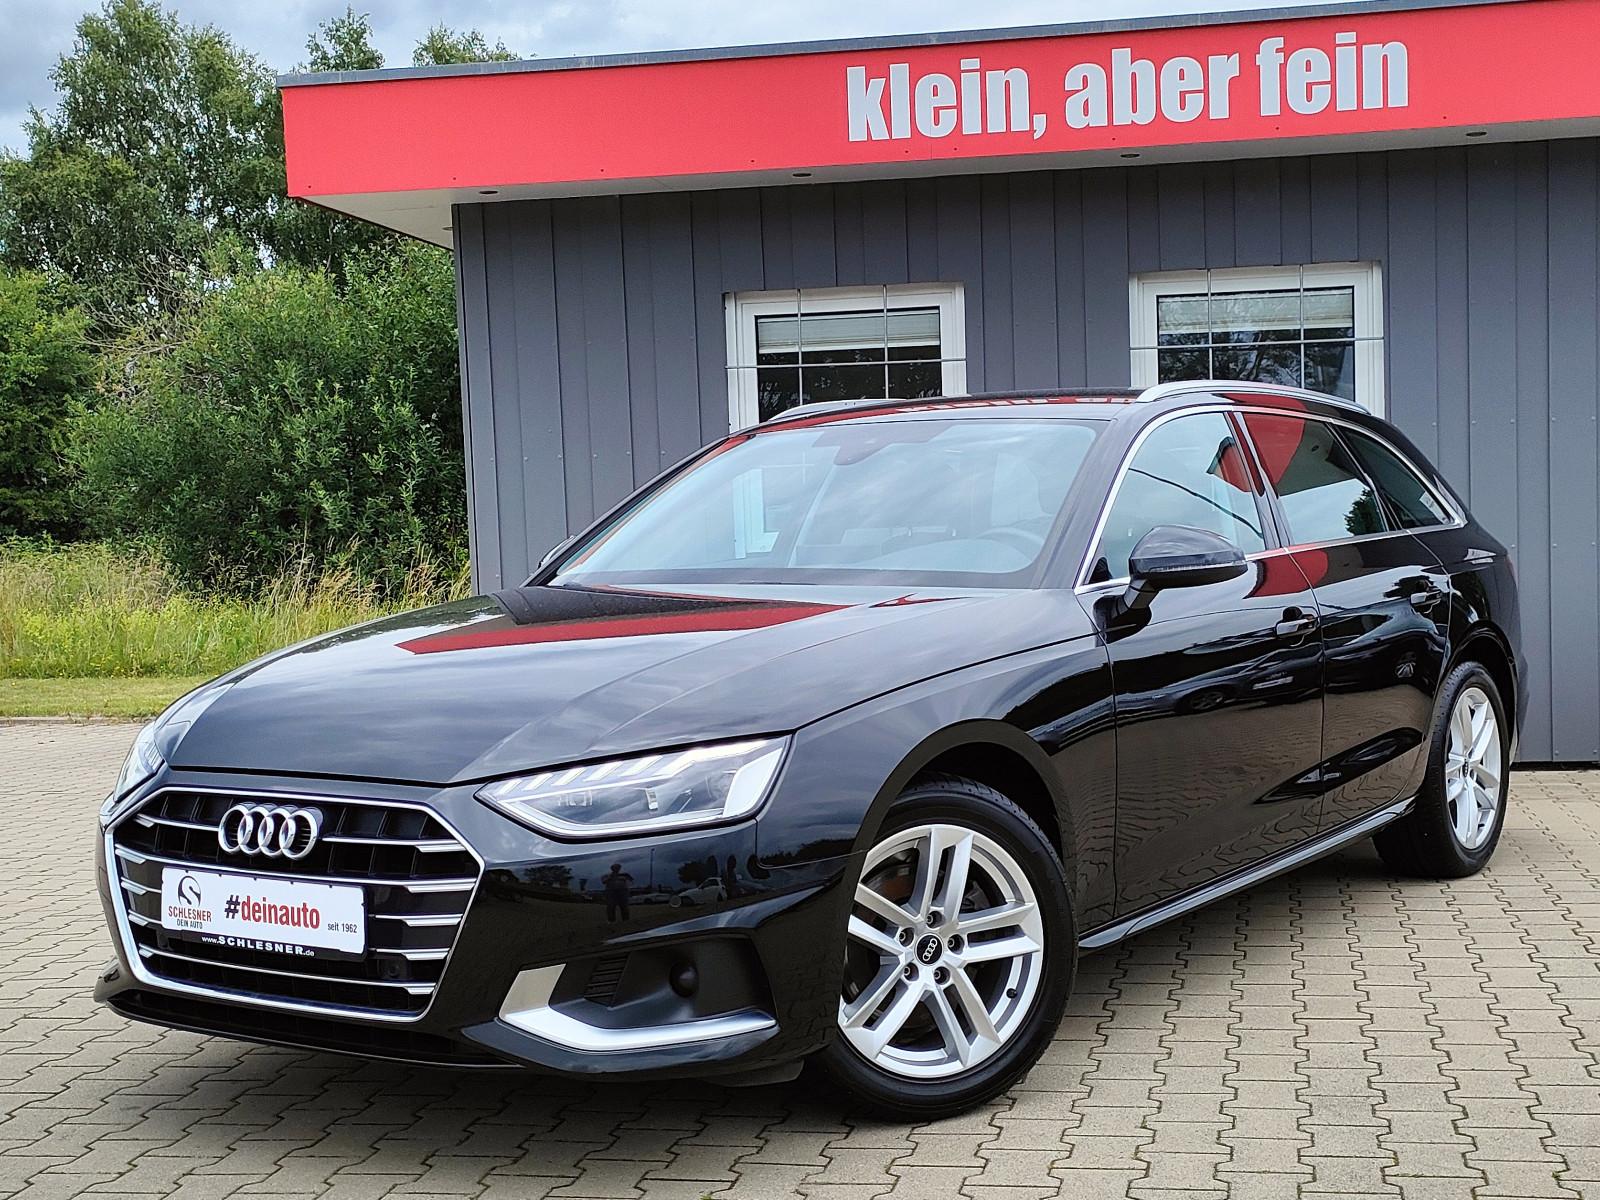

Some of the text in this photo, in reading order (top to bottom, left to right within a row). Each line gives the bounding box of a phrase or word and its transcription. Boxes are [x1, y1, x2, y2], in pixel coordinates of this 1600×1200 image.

[846, 31, 1410, 143] klein, aber fein
[168, 905, 212, 922] SCHLESNER
[224, 894, 321, 930] #deinauto
[177, 918, 203, 929] DEIN AUTO
[327, 921, 358, 933] seit 1962
[201, 935, 315, 957] www.SCHLESNER.de
